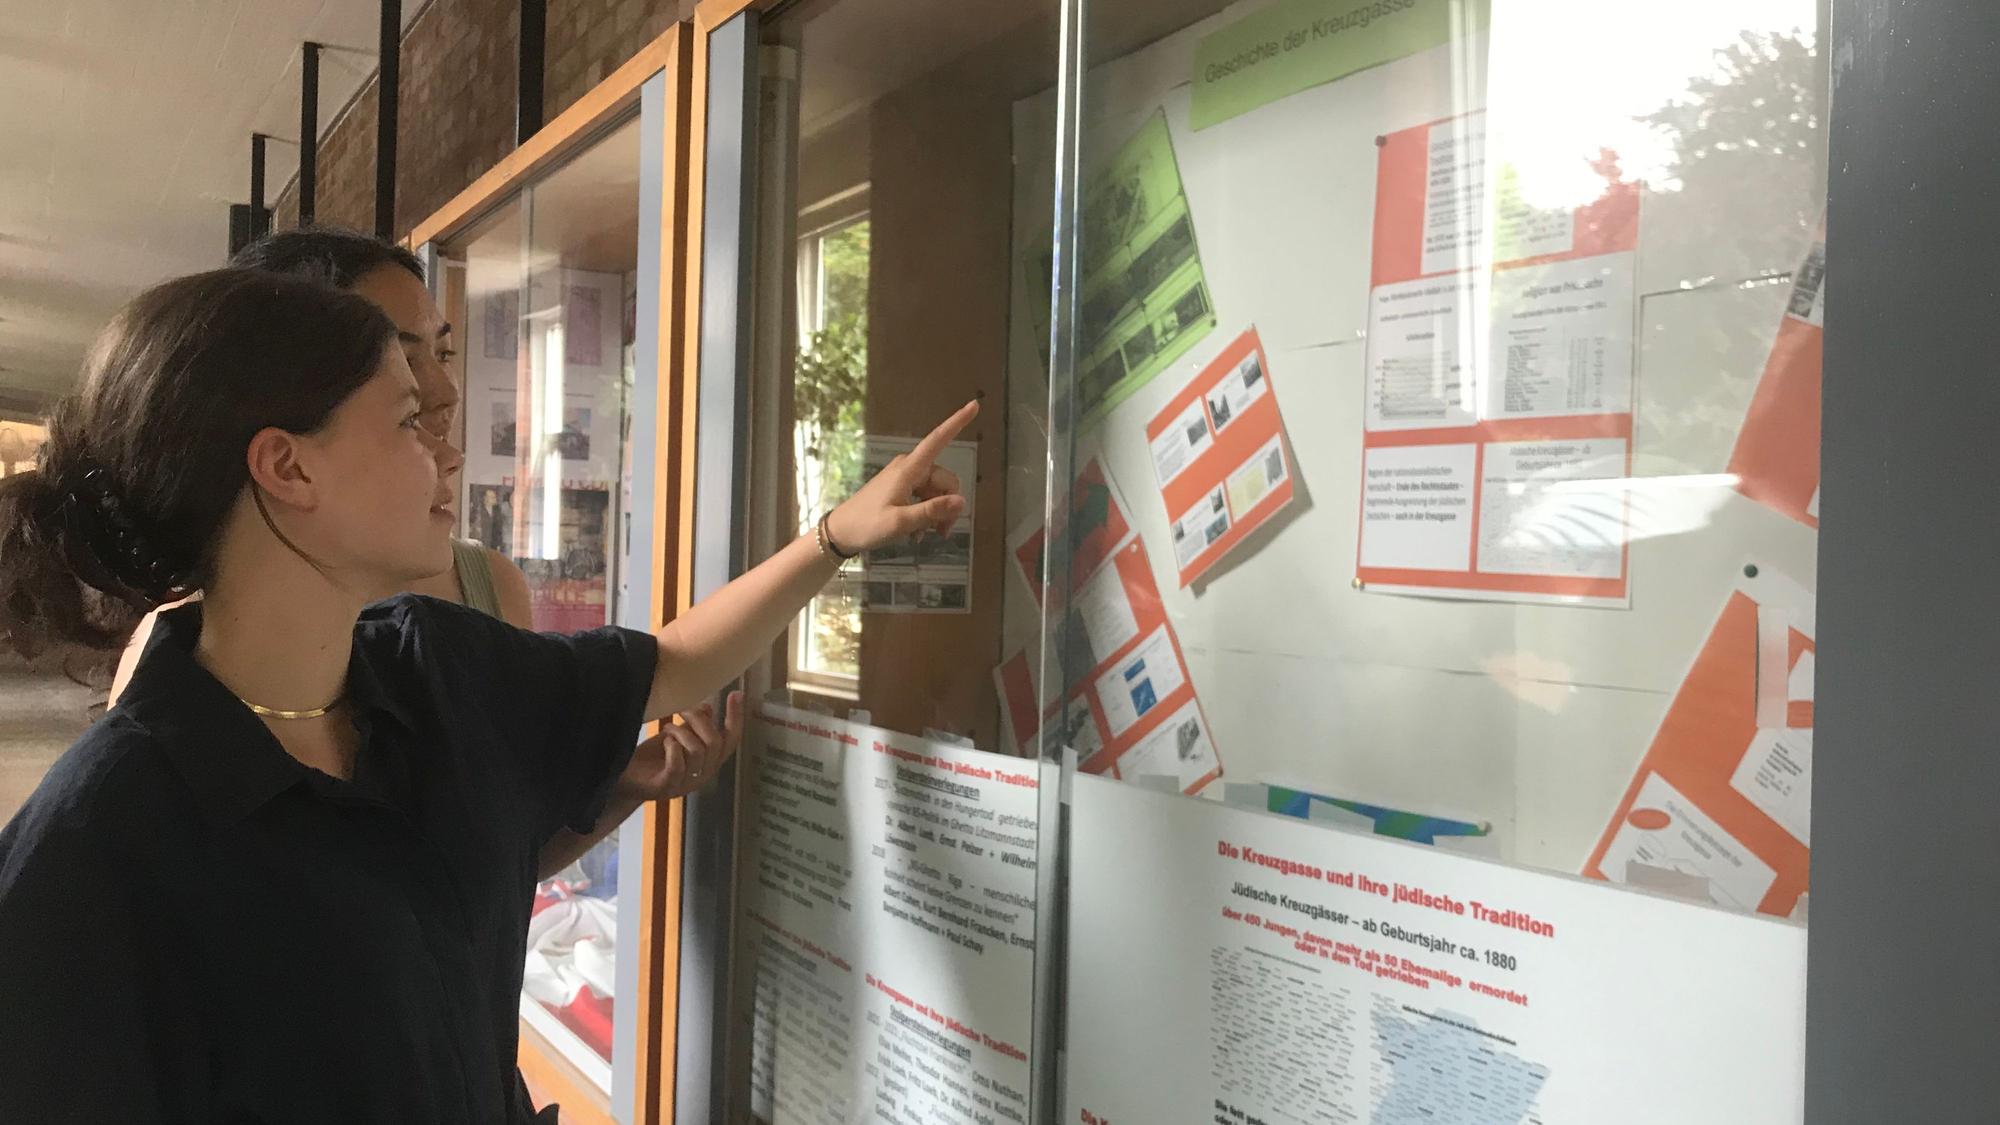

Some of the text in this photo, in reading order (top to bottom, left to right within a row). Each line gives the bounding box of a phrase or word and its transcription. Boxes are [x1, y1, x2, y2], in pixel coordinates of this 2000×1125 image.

[1204, 0, 1416, 82] Geschichte der Kreuzgasse
[954, 760, 991, 779] jüdische
[1217, 840, 1239, 859] Die
[1242, 846, 1322, 880] Kreuzgasse
[1326, 870, 1354, 888] und
[1392, 882, 1465, 916] jüdische
[1469, 900, 1554, 938] Tradition
[1231, 880, 1278, 906] Jüdische
[1280, 894, 1349, 925] Kreuzgässer
[1362, 918, 1378, 934] ab
[1380, 921, 1457, 955] Geburtsjahr
[1460, 945, 1480, 961] ca.
[1484, 950, 1517, 972] 1880
[1222, 904, 1242, 921] über
[1263, 918, 1300, 940] Jungen,
[1303, 931, 1333, 948] davon
[1336, 942, 1362, 956] mehr
[1365, 950, 1381, 963] als
[1384, 953, 1398, 967] 50
[1401, 958, 1462, 988] Ehemalige
[1469, 980, 1528, 1007] ermordet
[1294, 941, 1430, 990] oder in den Tod getrieben
